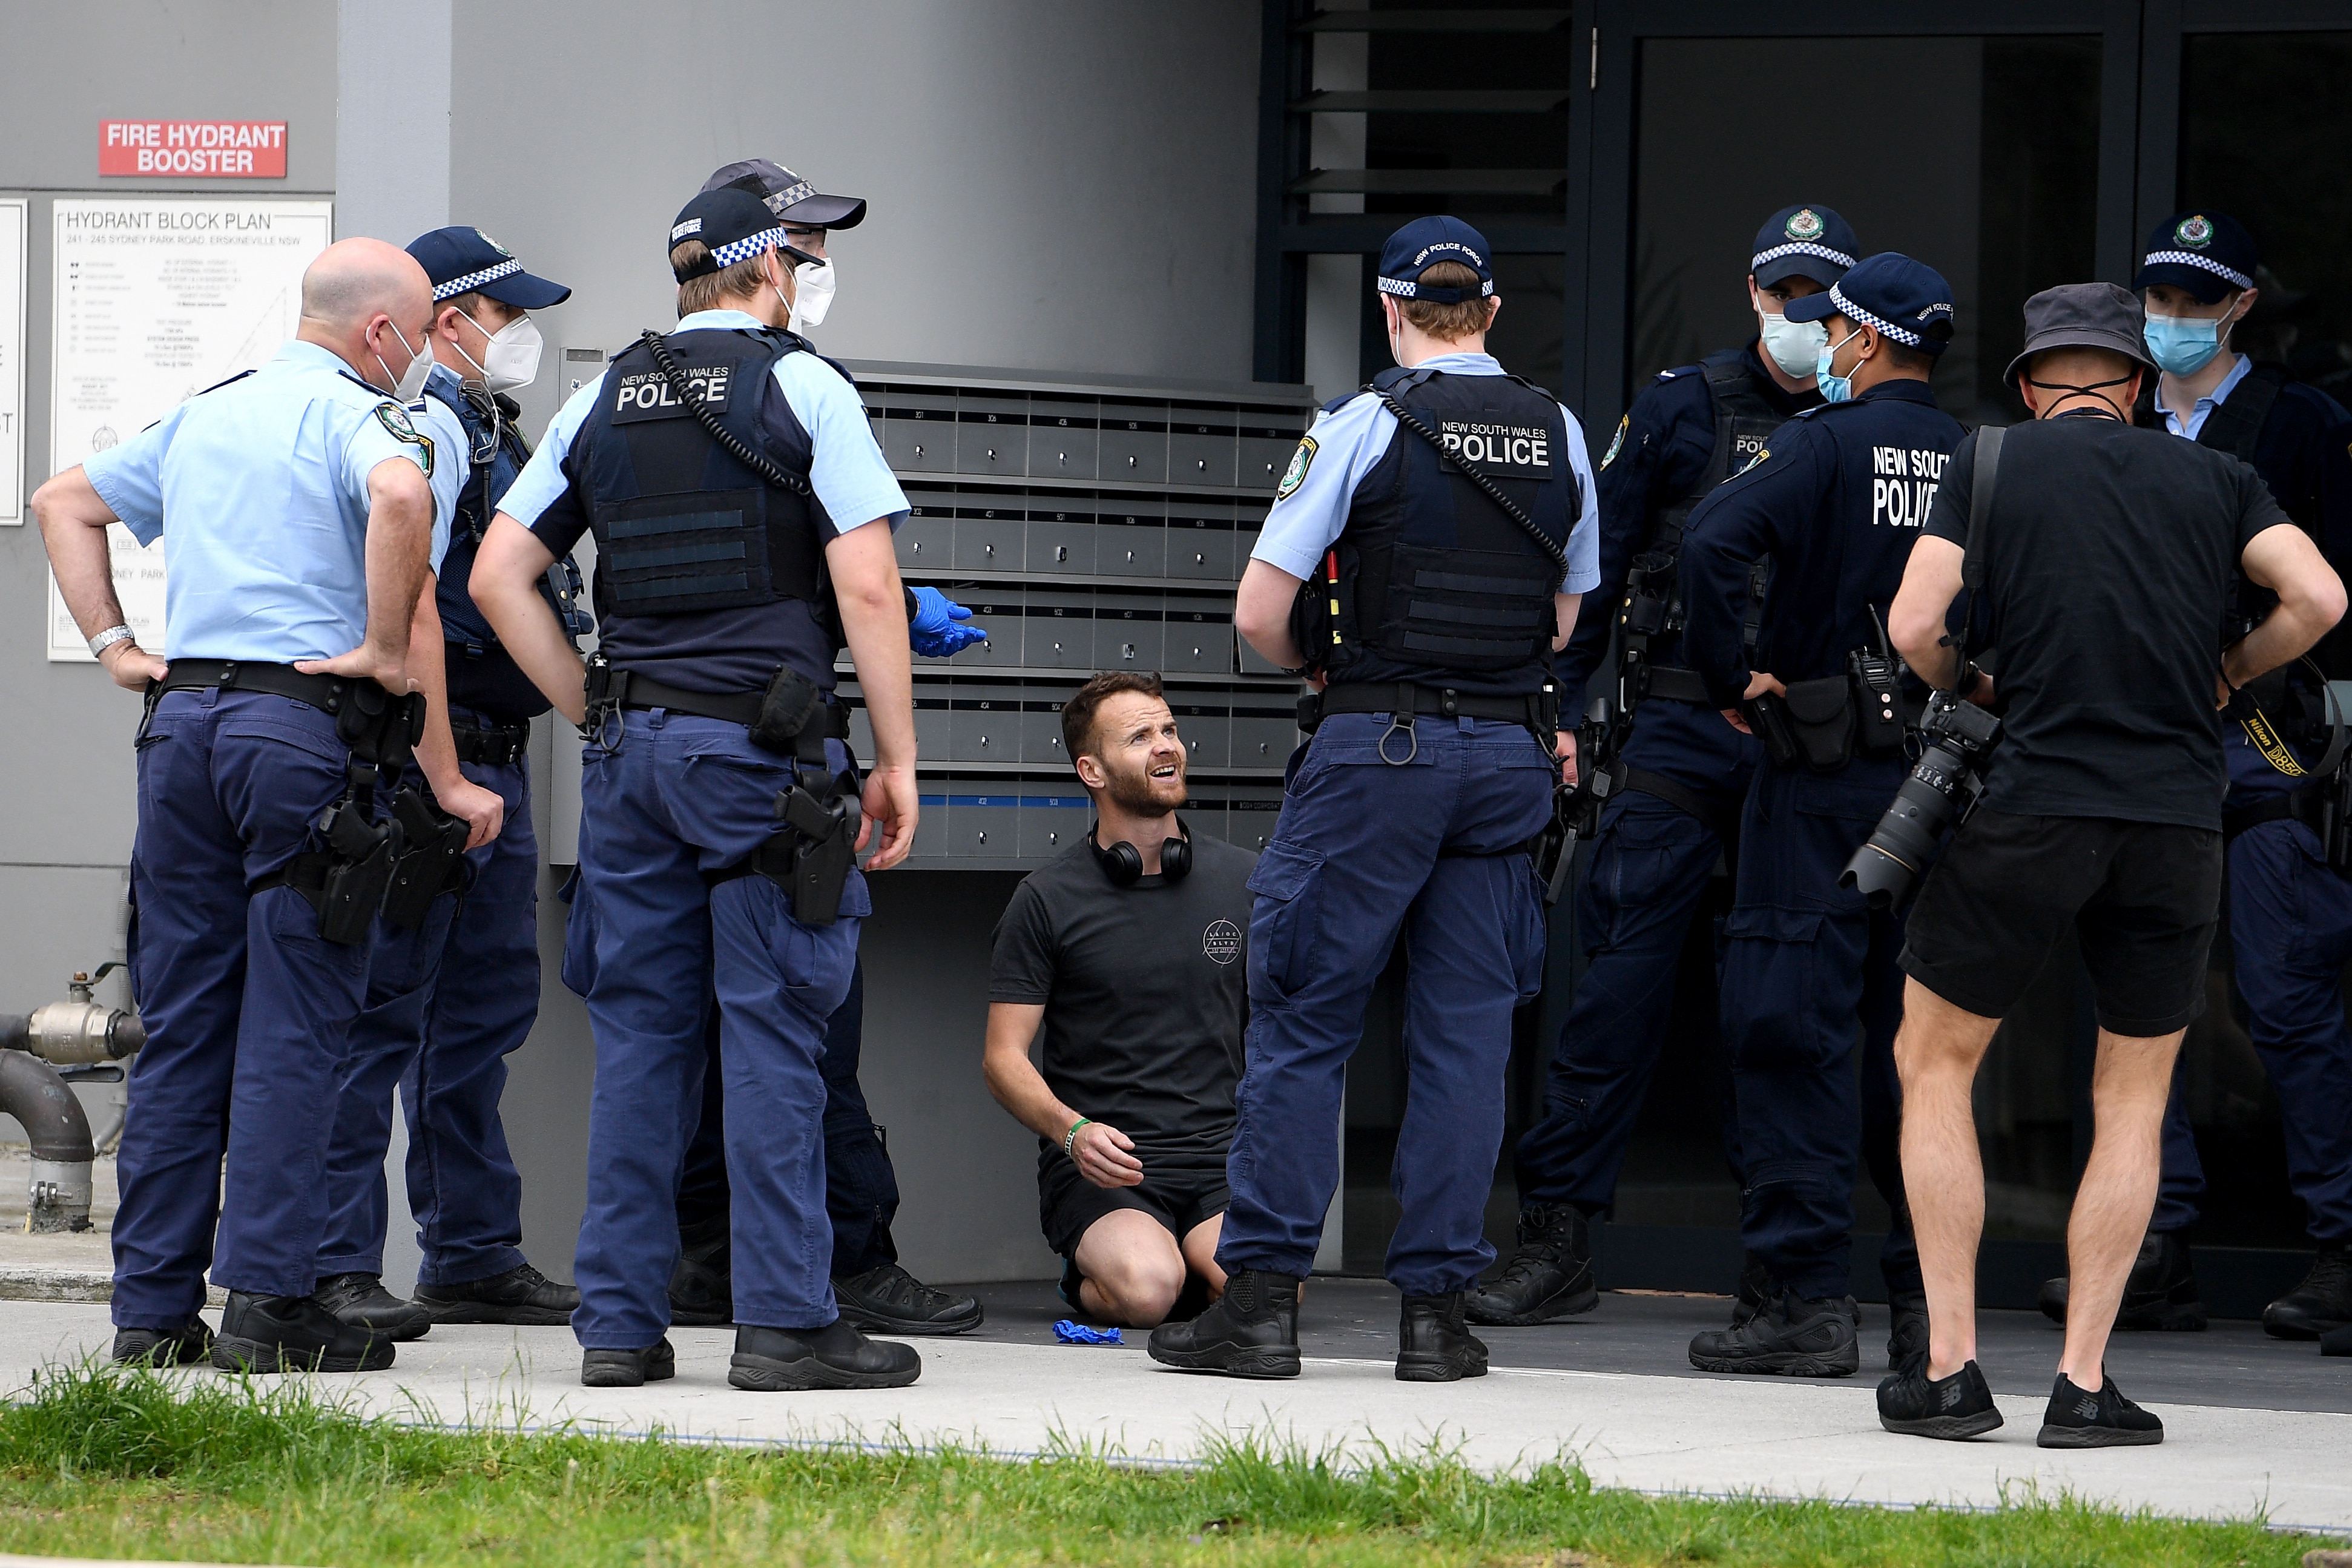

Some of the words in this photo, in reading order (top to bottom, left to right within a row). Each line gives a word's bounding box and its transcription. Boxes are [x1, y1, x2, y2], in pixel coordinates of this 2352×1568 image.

[107, 123, 161, 147] FIRE
[167, 124, 285, 148] HYDRANT
[137, 149, 254, 173] BOOSTER
[67, 211, 153, 229] HYDRANT
[158, 211, 220, 229] BLOCK
[225, 212, 271, 230] PLAN
[67, 235, 82, 243] 241
[91, 235, 106, 243] 245
[109, 235, 147, 244] SYDNEY
[150, 236, 175, 244] PARK
[210, 236, 276, 246] ERSKINEVILLE
[278, 236, 300, 246] NSW
[1414, 248, 1429, 266] NSW
[1429, 242, 1460, 252] POLICE
[1461, 246, 1483, 267] FORCE
[1917, 306, 1933, 321] NSW
[1932, 303, 1951, 312] POLICE
[621, 374, 647, 386] NEW
[689, 367, 729, 378] WALES
[616, 377, 728, 412] POLCE
[1442, 421, 1468, 433] NEW
[1471, 423, 1509, 436] SOUTH
[1510, 426, 1546, 440] WALES
[1442, 433, 1549, 467] POLICE
[1873, 446, 1907, 476] NEW
[2248, 718, 2271, 746] Nikon
[2267, 745, 2302, 775] D850
